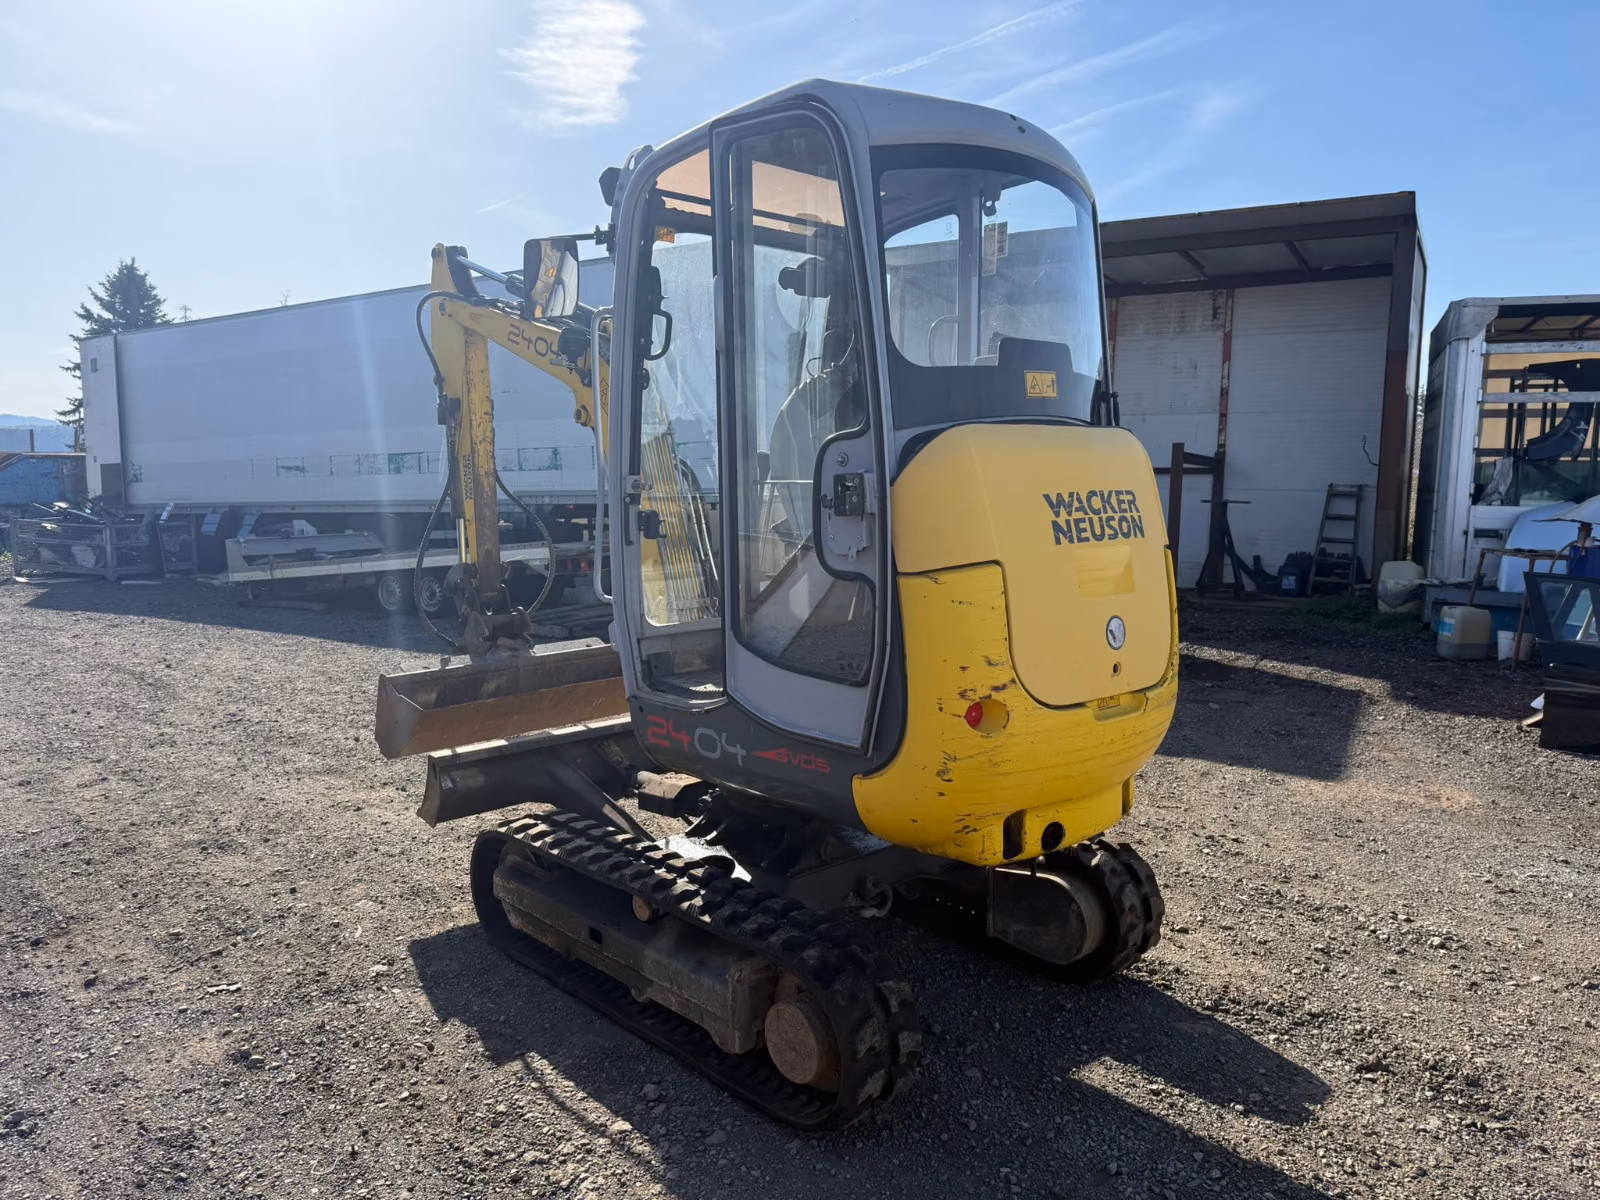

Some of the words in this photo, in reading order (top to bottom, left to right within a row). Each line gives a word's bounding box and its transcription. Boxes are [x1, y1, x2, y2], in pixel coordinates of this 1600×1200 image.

[1042, 489, 1141, 518] WACKER
[1051, 515, 1145, 545] NEUSON
[647, 715, 746, 767] 2404
